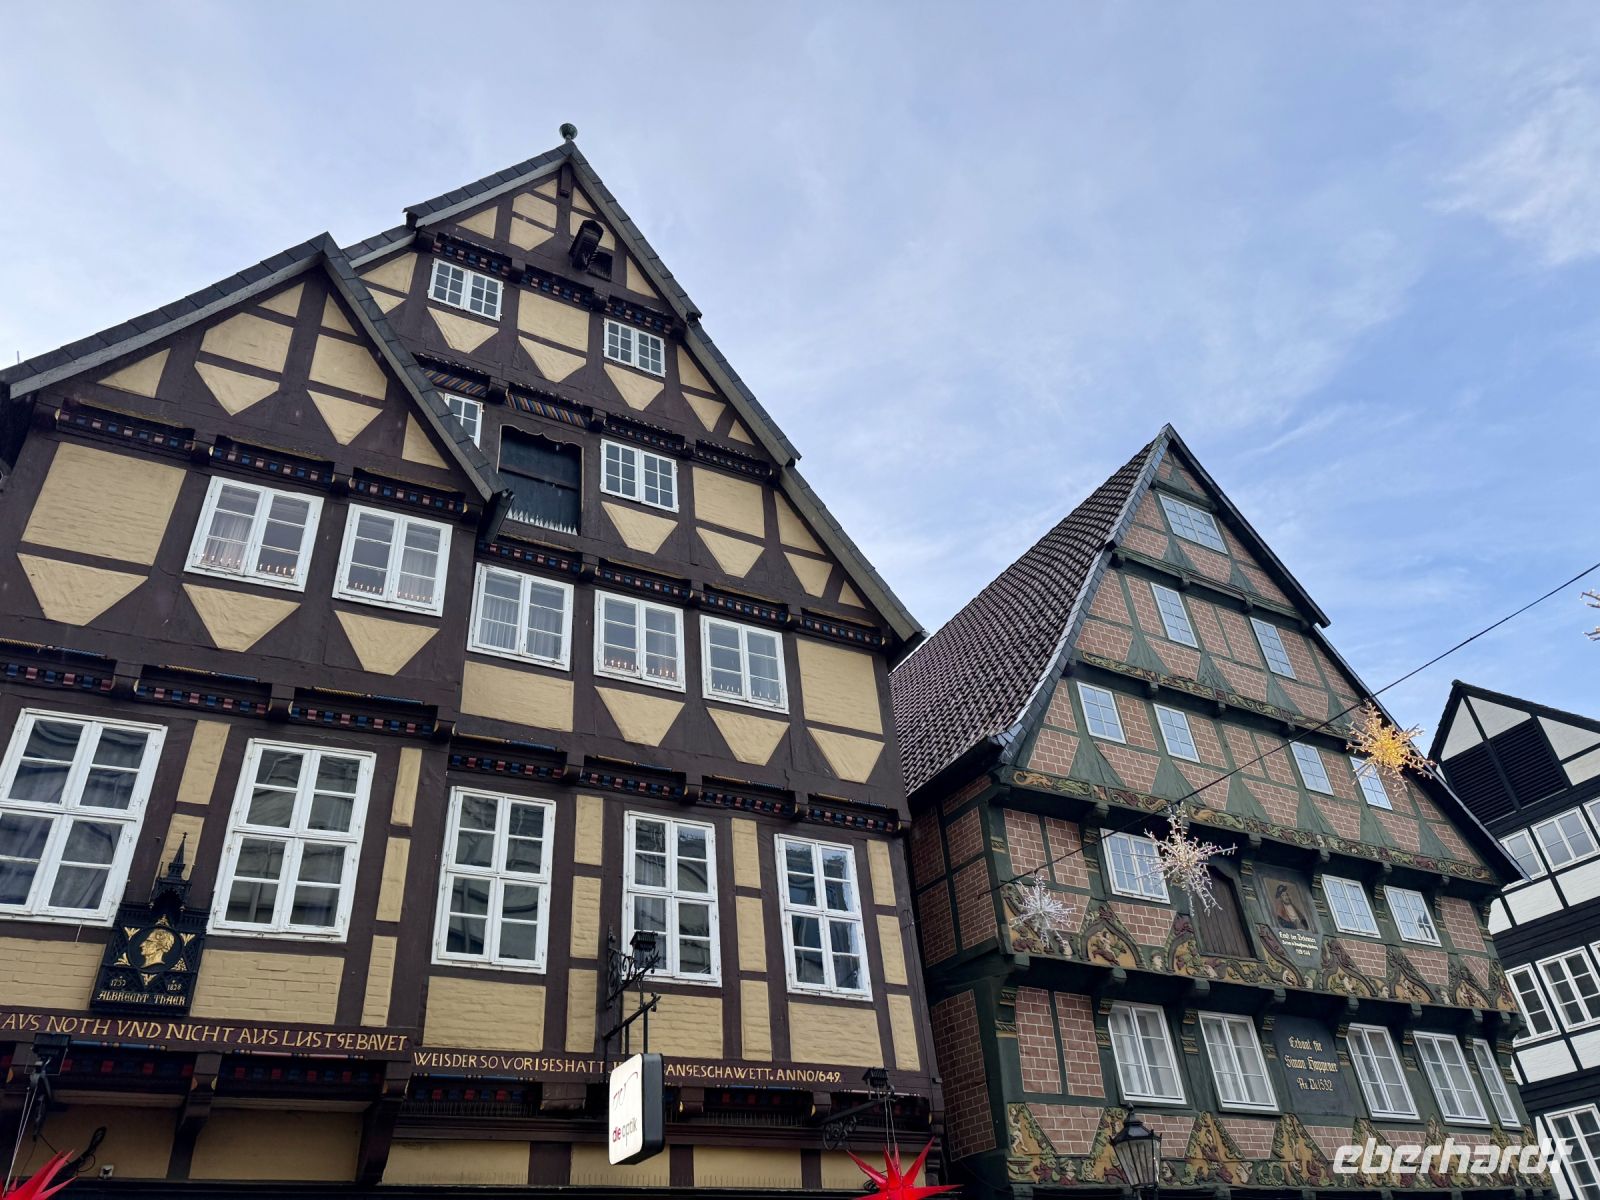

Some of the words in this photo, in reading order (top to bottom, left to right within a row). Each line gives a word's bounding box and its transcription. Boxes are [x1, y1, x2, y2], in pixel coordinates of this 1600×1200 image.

[1, 1013, 42, 1030] AVS
[46, 1015, 113, 1035] NOTH
[117, 1019, 162, 1040] VND
[165, 1023, 235, 1043] NICHT
